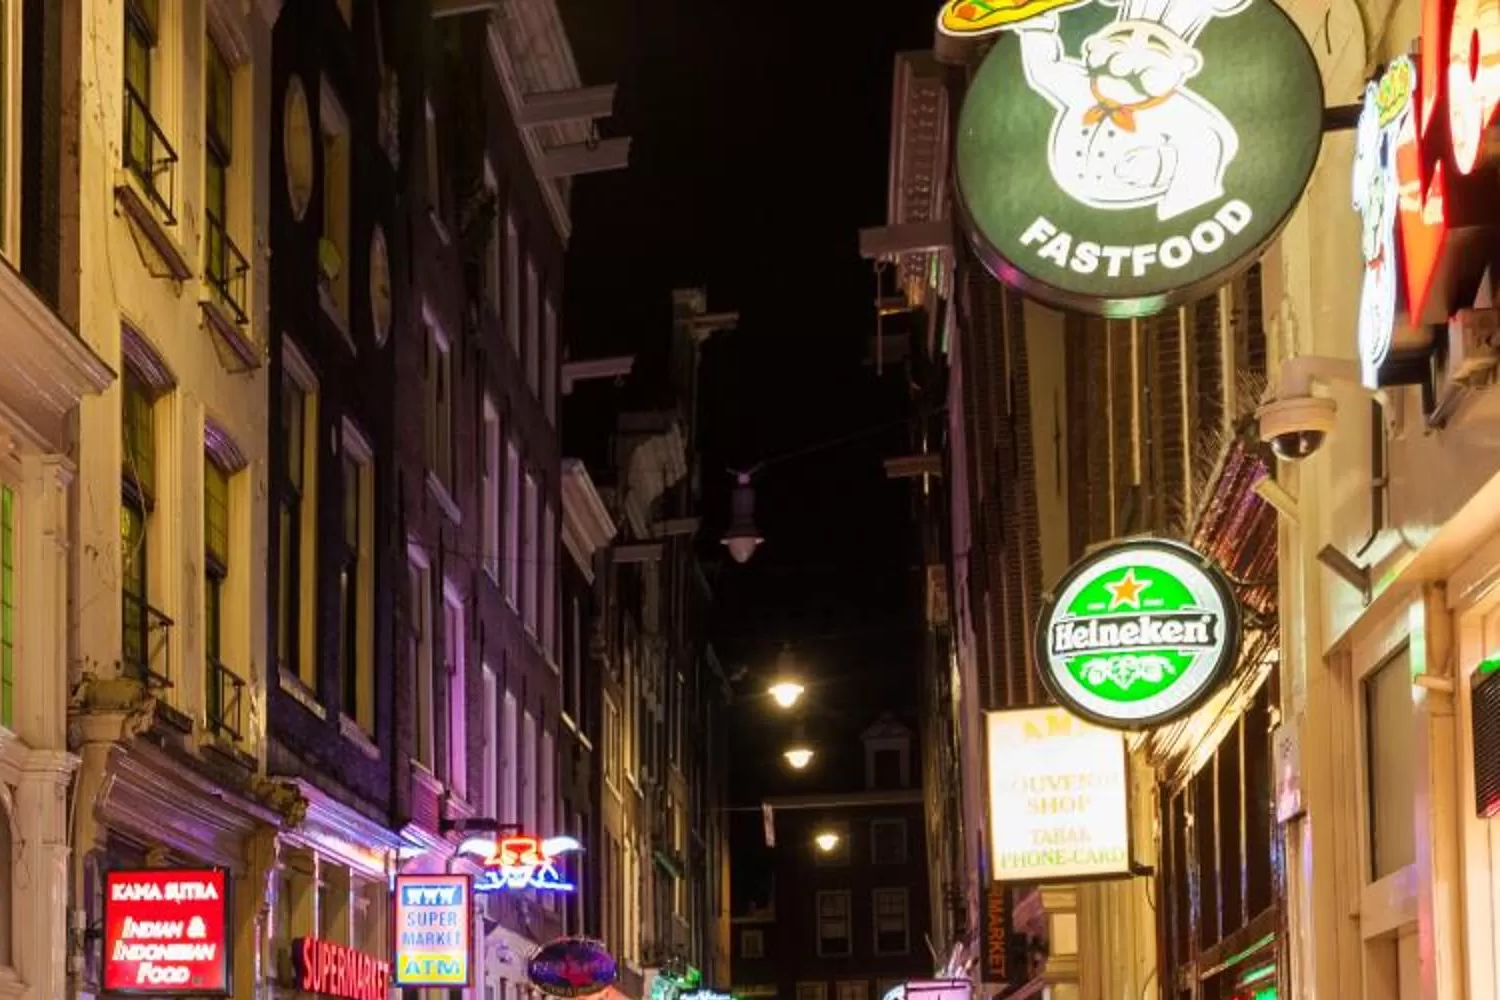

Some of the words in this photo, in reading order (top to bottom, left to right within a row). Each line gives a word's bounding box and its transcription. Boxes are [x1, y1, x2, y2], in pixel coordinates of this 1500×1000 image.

[1019, 197, 1254, 278] FASTFOOD
[1055, 614, 1209, 651] Heineken
[1027, 794, 1092, 816] SHOP
[111, 882, 162, 901] KAMA
[164, 881, 219, 902] SUTRA
[407, 911, 457, 927] SUPER
[403, 931, 461, 946] MARKET
[405, 959, 461, 975] ATM
